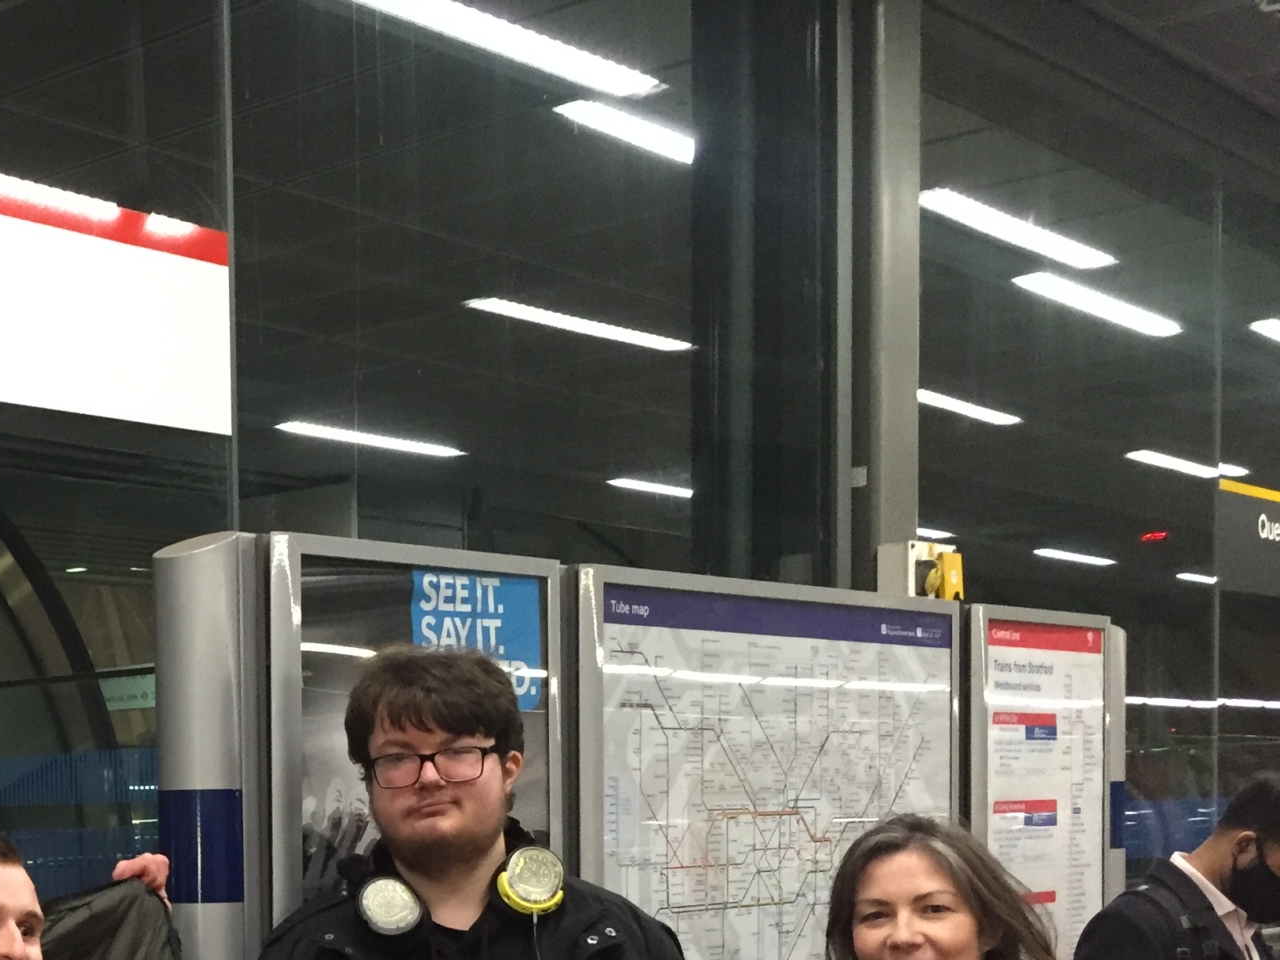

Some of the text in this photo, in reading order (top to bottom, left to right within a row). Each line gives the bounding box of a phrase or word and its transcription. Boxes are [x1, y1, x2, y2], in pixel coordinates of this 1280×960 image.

[420, 573, 504, 614] SEE IT.
[610, 600, 650, 618] Tube map
[421, 615, 505, 655] SAY IT.
[993, 659, 1054, 675] Trains from Stratford
